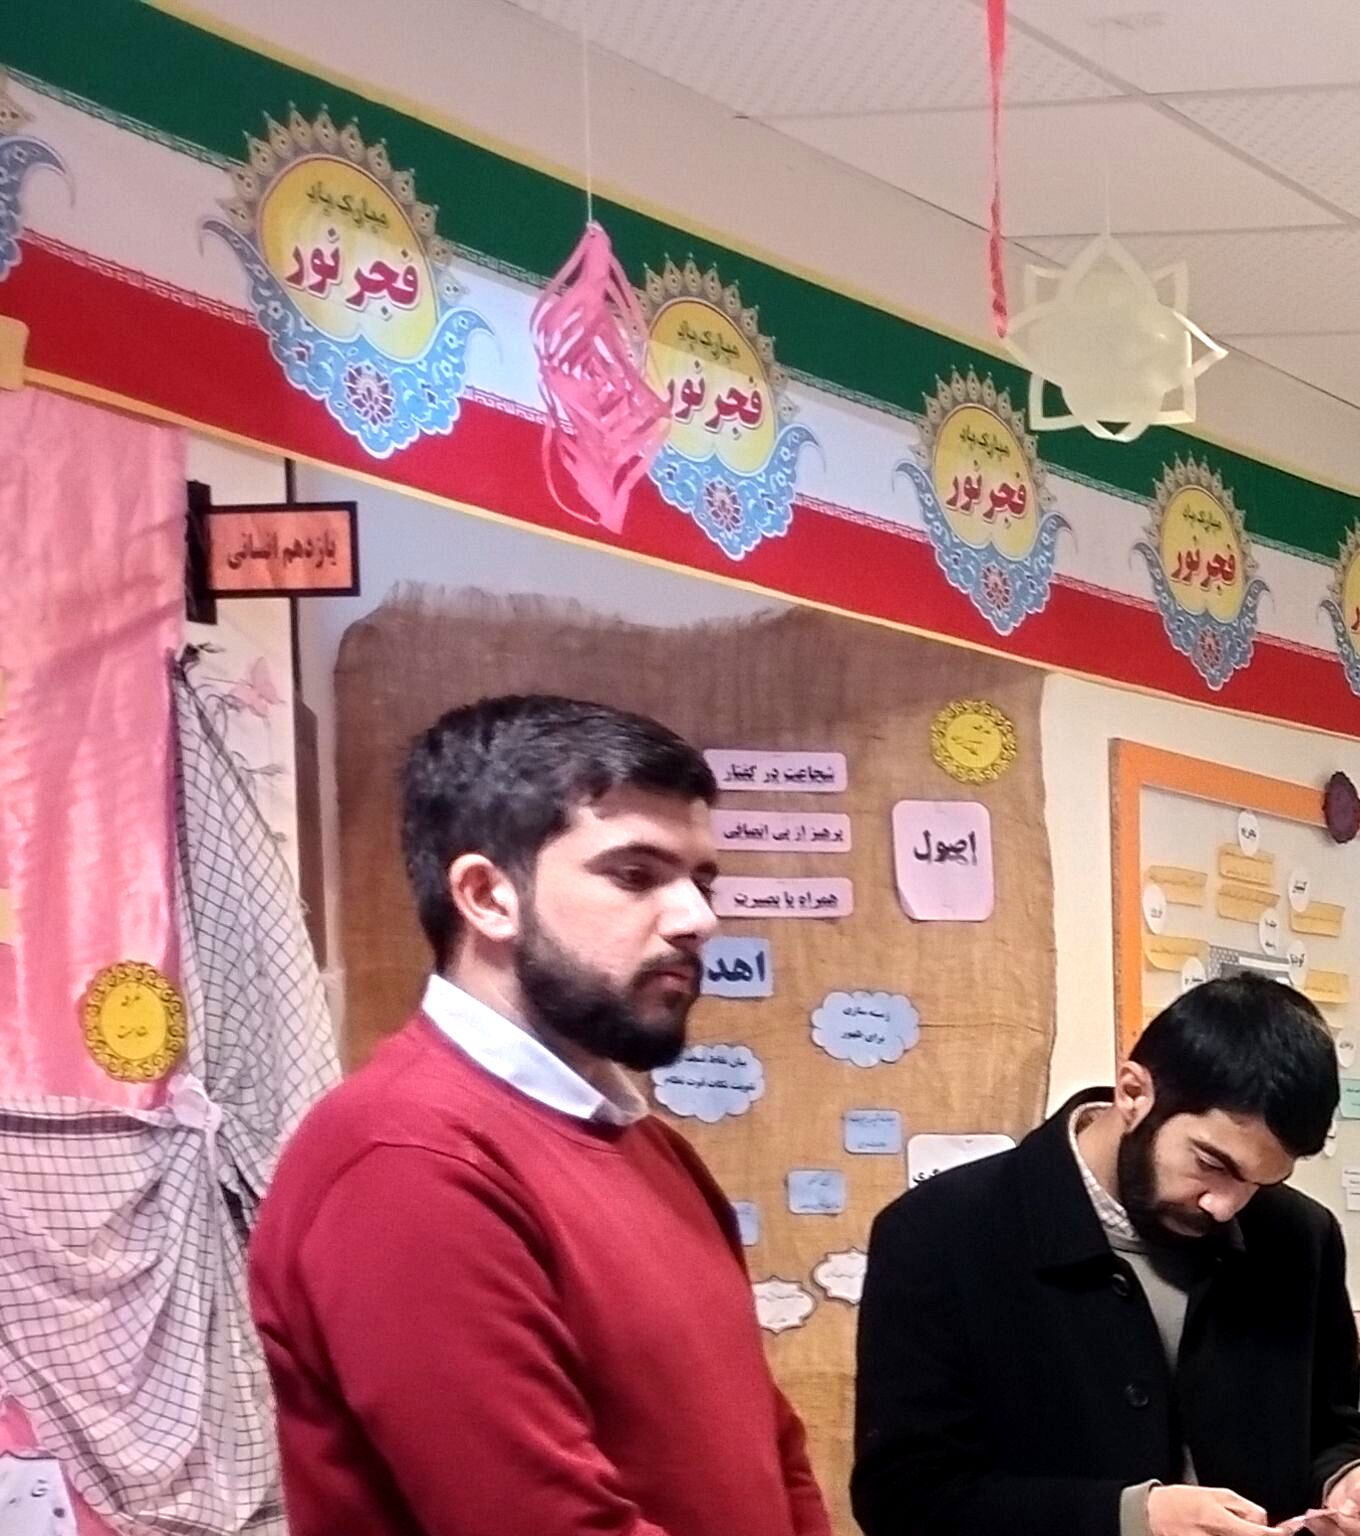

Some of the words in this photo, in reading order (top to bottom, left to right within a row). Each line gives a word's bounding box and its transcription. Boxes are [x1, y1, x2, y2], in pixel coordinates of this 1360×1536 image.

[306, 181, 335, 216] باد
[338, 194, 389, 234] مبارک
[285, 227, 342, 296] نور
[345, 249, 419, 315] فجر
[704, 375, 762, 434] فجر
[945, 460, 983, 513] نور
[982, 472, 1027, 524] فجر
[226, 531, 279, 570] انسانی
[282, 530, 337, 568] یازدهم
[1170, 535, 1200, 583] نور
[1199, 543, 1236, 594] فجر
[762, 768, 780, 783] در
[783, 765, 835, 783] شجاعت
[913, 829, 977, 866] اصول
